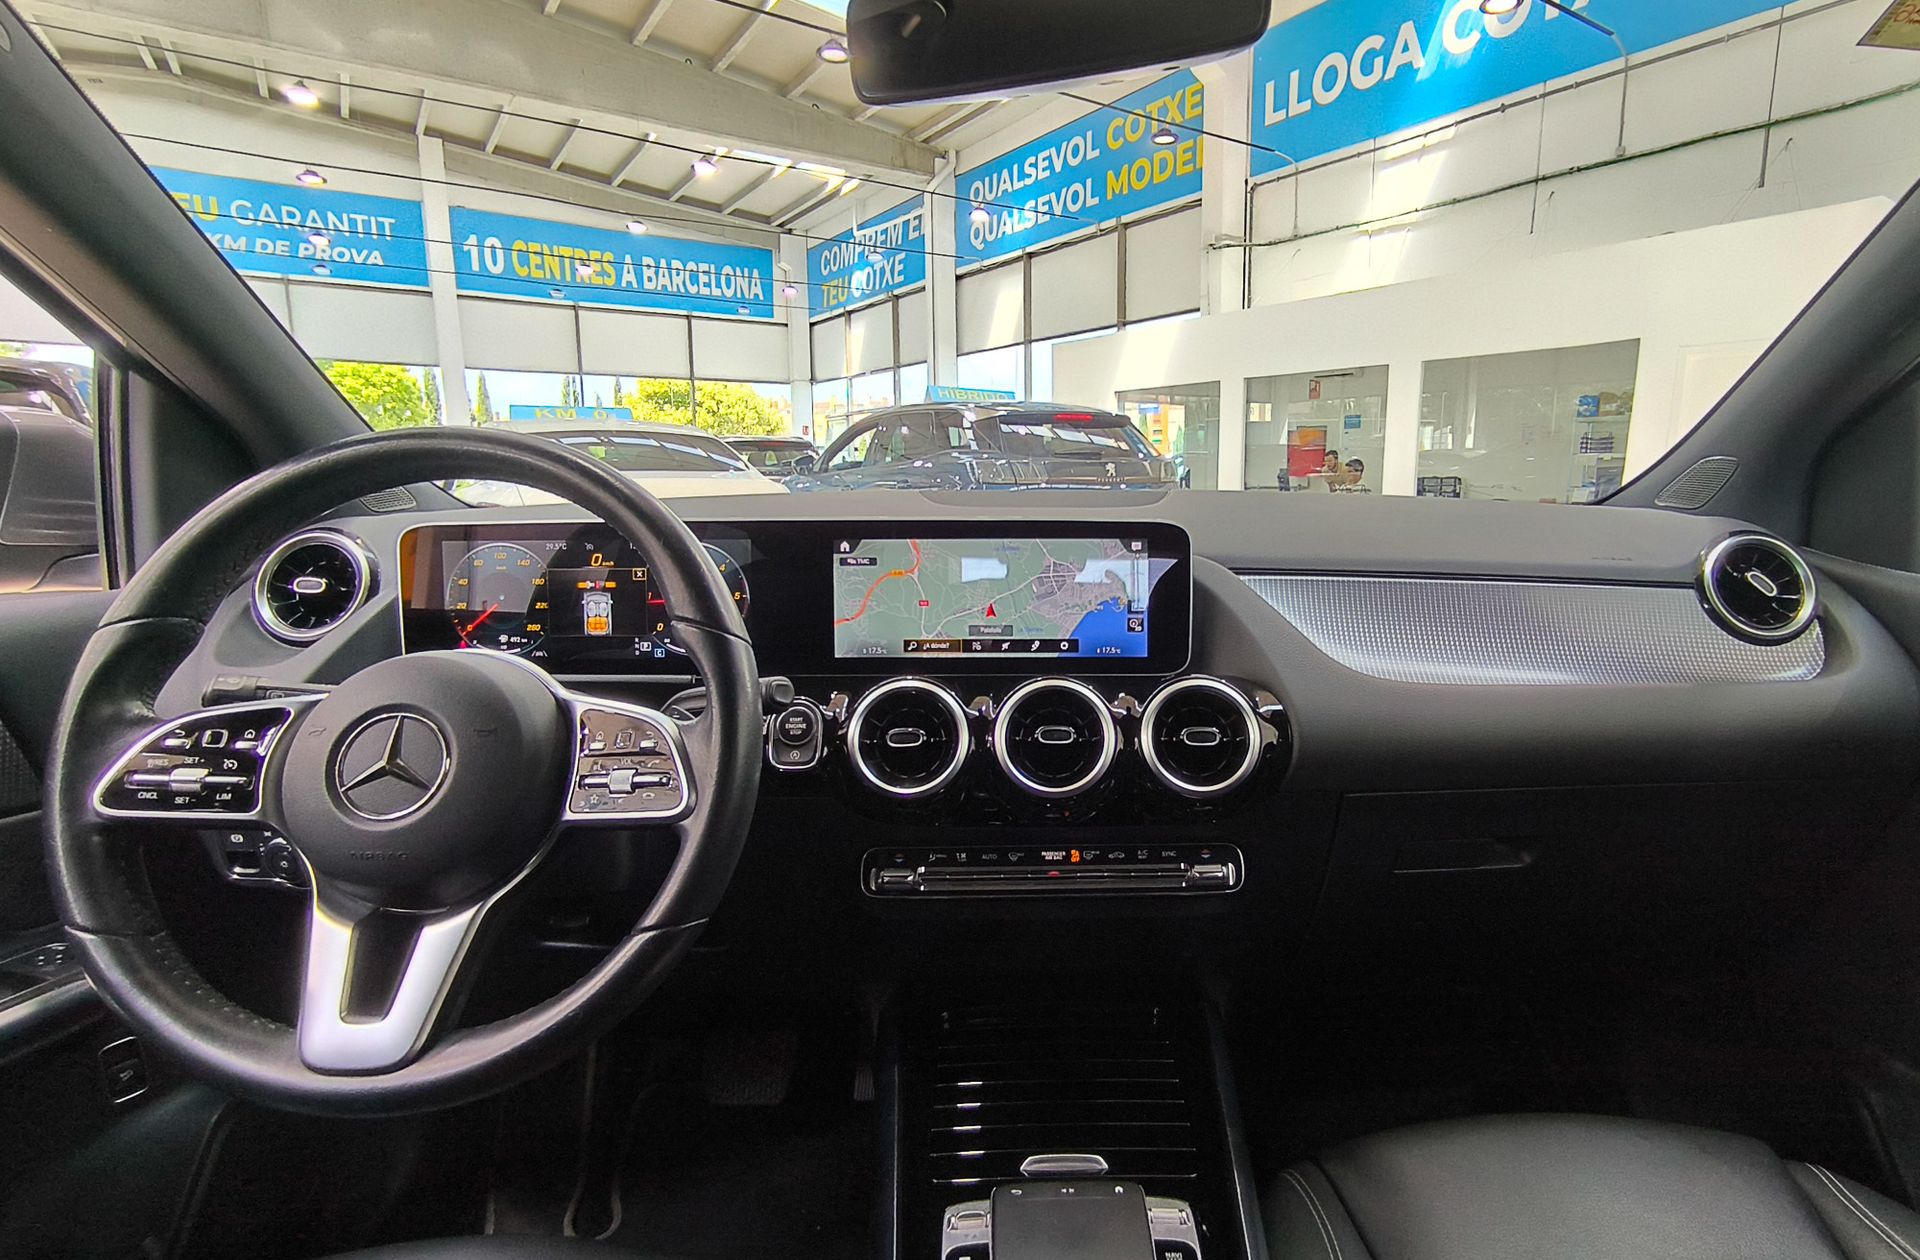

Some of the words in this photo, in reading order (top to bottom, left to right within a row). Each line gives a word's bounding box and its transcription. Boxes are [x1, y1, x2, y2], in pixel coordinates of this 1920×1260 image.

[1265, 20, 1426, 127] LLOGA
[970, 130, 1100, 206] QUALSEVOL
[1107, 82, 1203, 150] COTXE
[230, 200, 395, 241] GARANTIT
[970, 177, 1100, 251] QUALSEVOL
[255, 236, 290, 256] DE
[300, 243, 384, 266] PROVA
[463, 234, 505, 274] 10
[512, 239, 616, 287] CENTRES
[621, 254, 638, 289] A
[642, 256, 764, 300] BARCELONA
[821, 223, 902, 276] COMPREM
[822, 275, 849, 308] TEU
[851, 252, 906, 298] COTXE
[535, 407, 577, 420] KM
[138, 791, 158, 799] CNCL
[174, 796, 190, 804] SET
